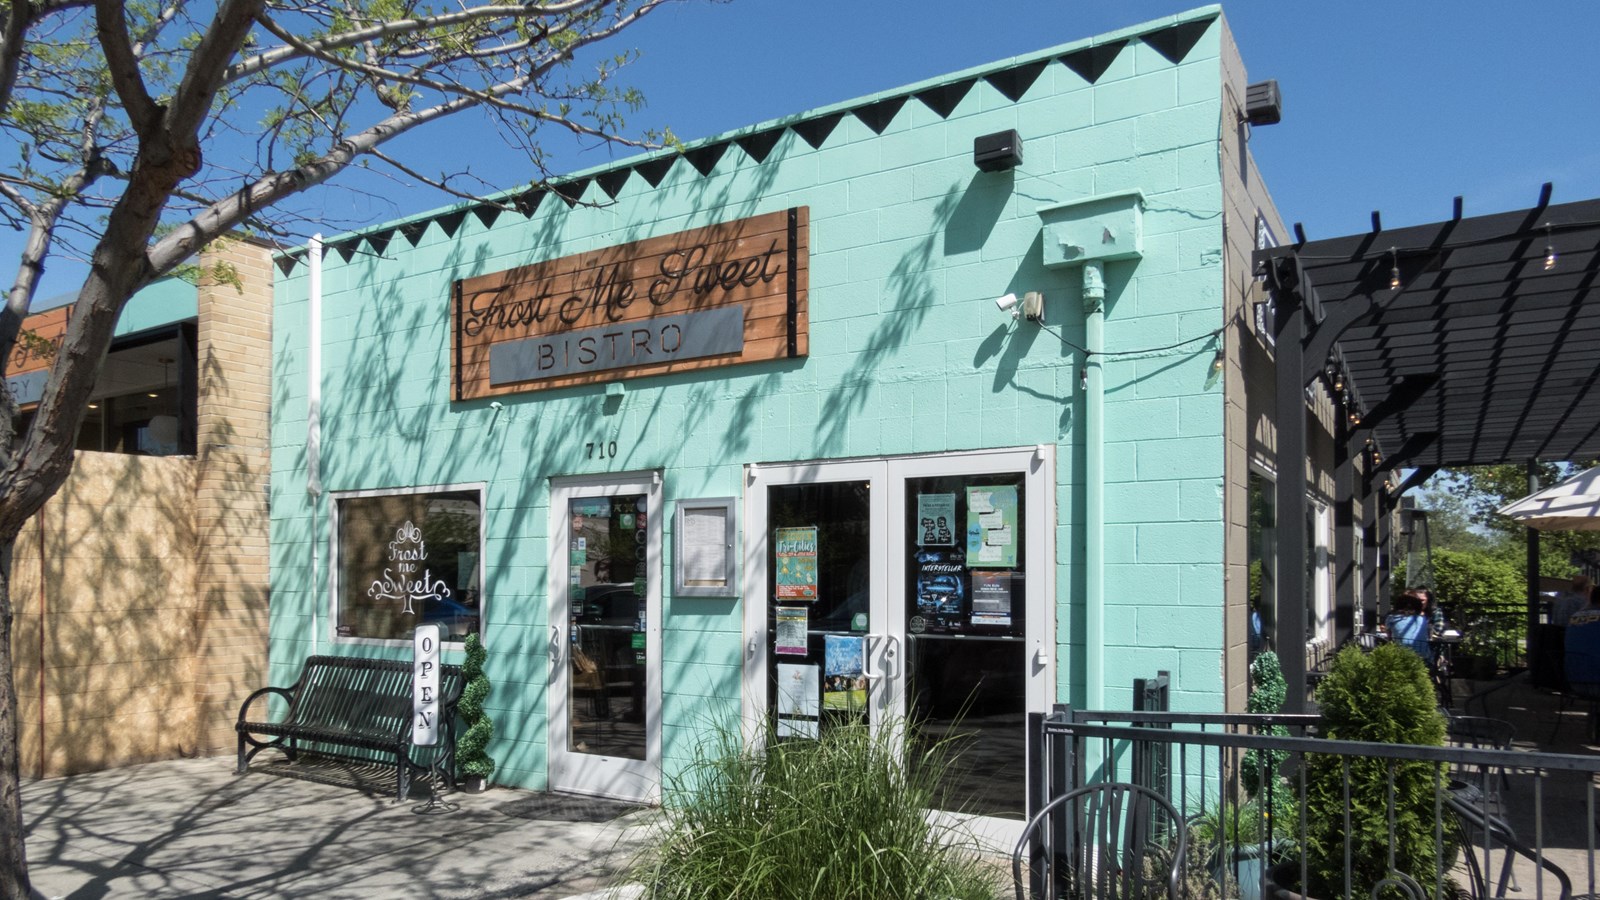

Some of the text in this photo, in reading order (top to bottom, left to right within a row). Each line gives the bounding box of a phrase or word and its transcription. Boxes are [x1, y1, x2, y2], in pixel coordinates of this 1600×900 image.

[465, 238, 784, 337] Frost Me Sweet
[537, 324, 682, 371] BISTRO
[586, 441, 617, 459] 710
[388, 541, 428, 561] Frost
[399, 562, 417, 573] me
[921, 564, 963, 573] INTERSTELLAR
[383, 568, 434, 593] Sweet
[418, 637, 433, 728] OPEN
